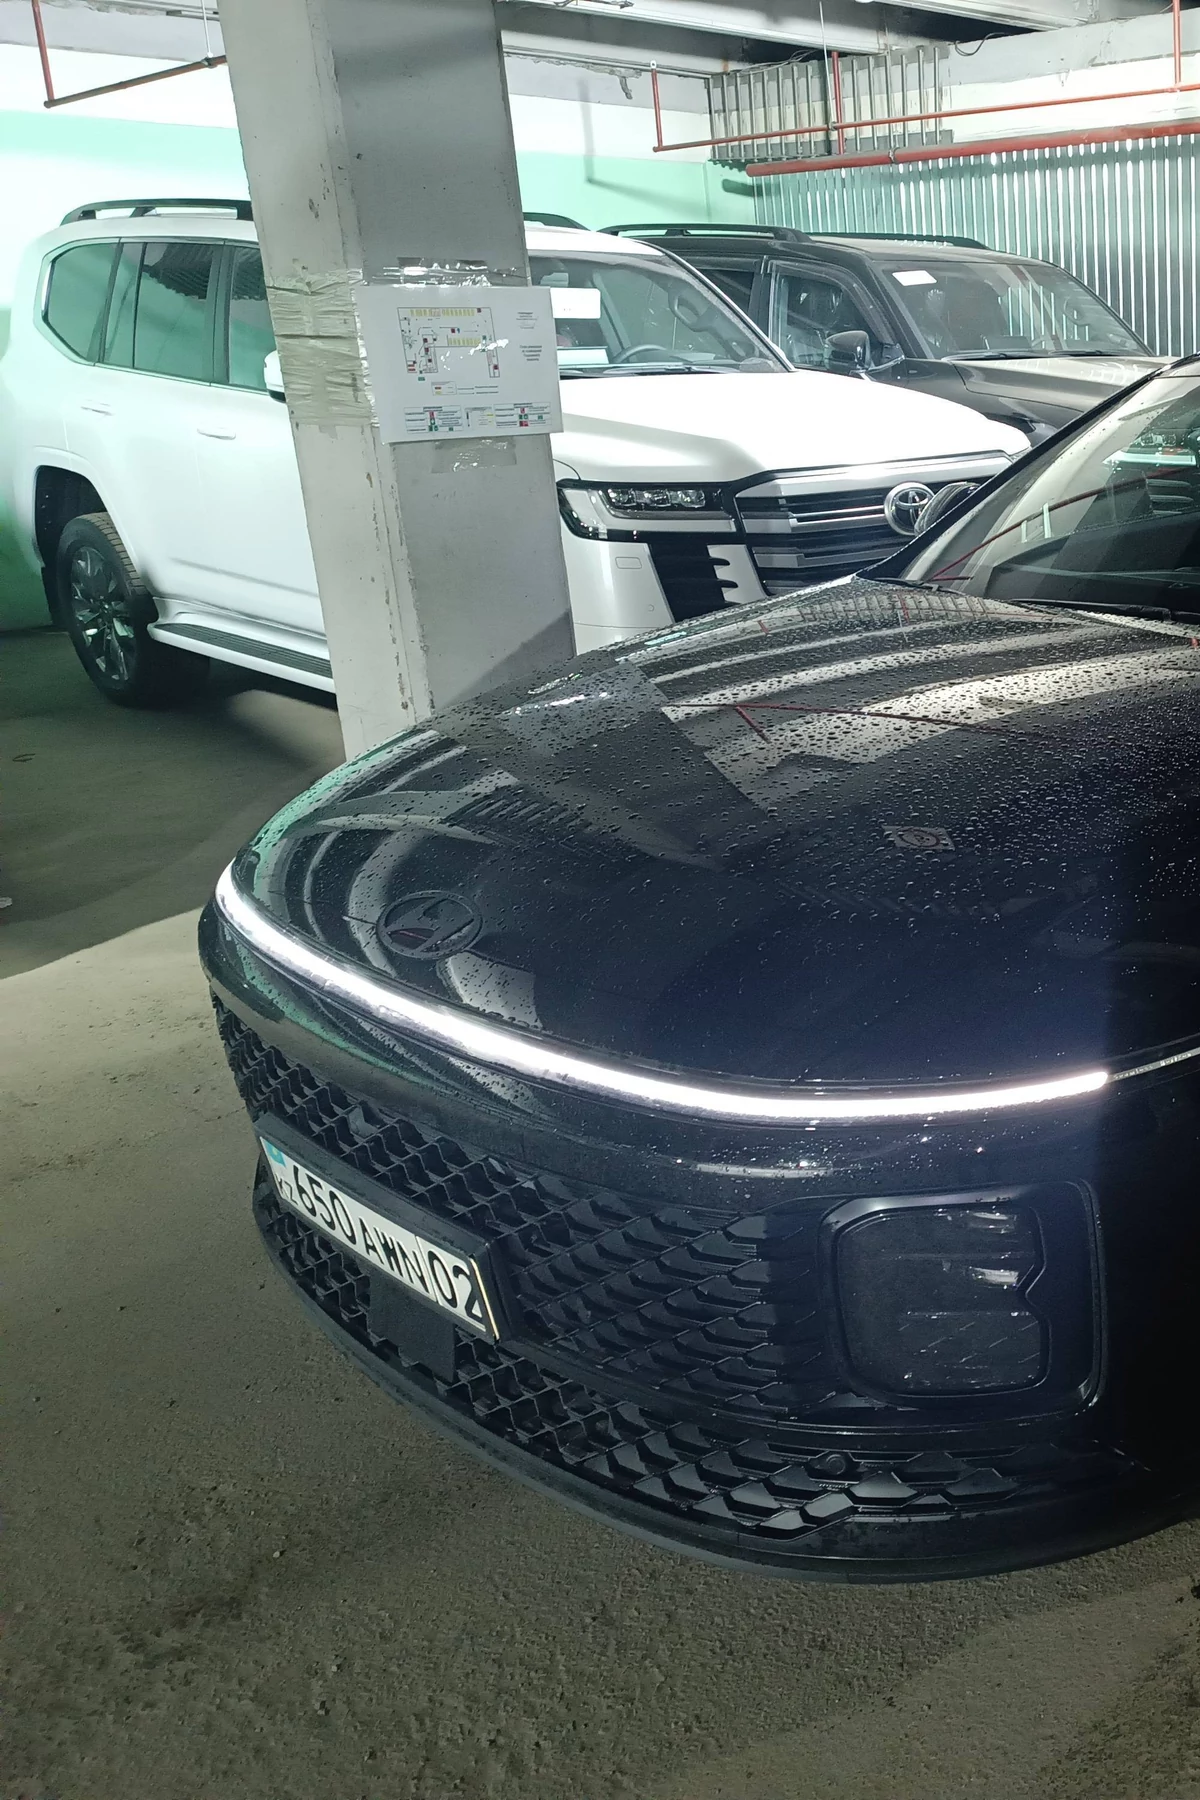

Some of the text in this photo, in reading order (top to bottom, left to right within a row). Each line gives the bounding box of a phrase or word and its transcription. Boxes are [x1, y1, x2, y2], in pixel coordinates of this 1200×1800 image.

[274, 1173, 299, 1206] KZ
[293, 1164, 483, 1318] 650 AWN 02
